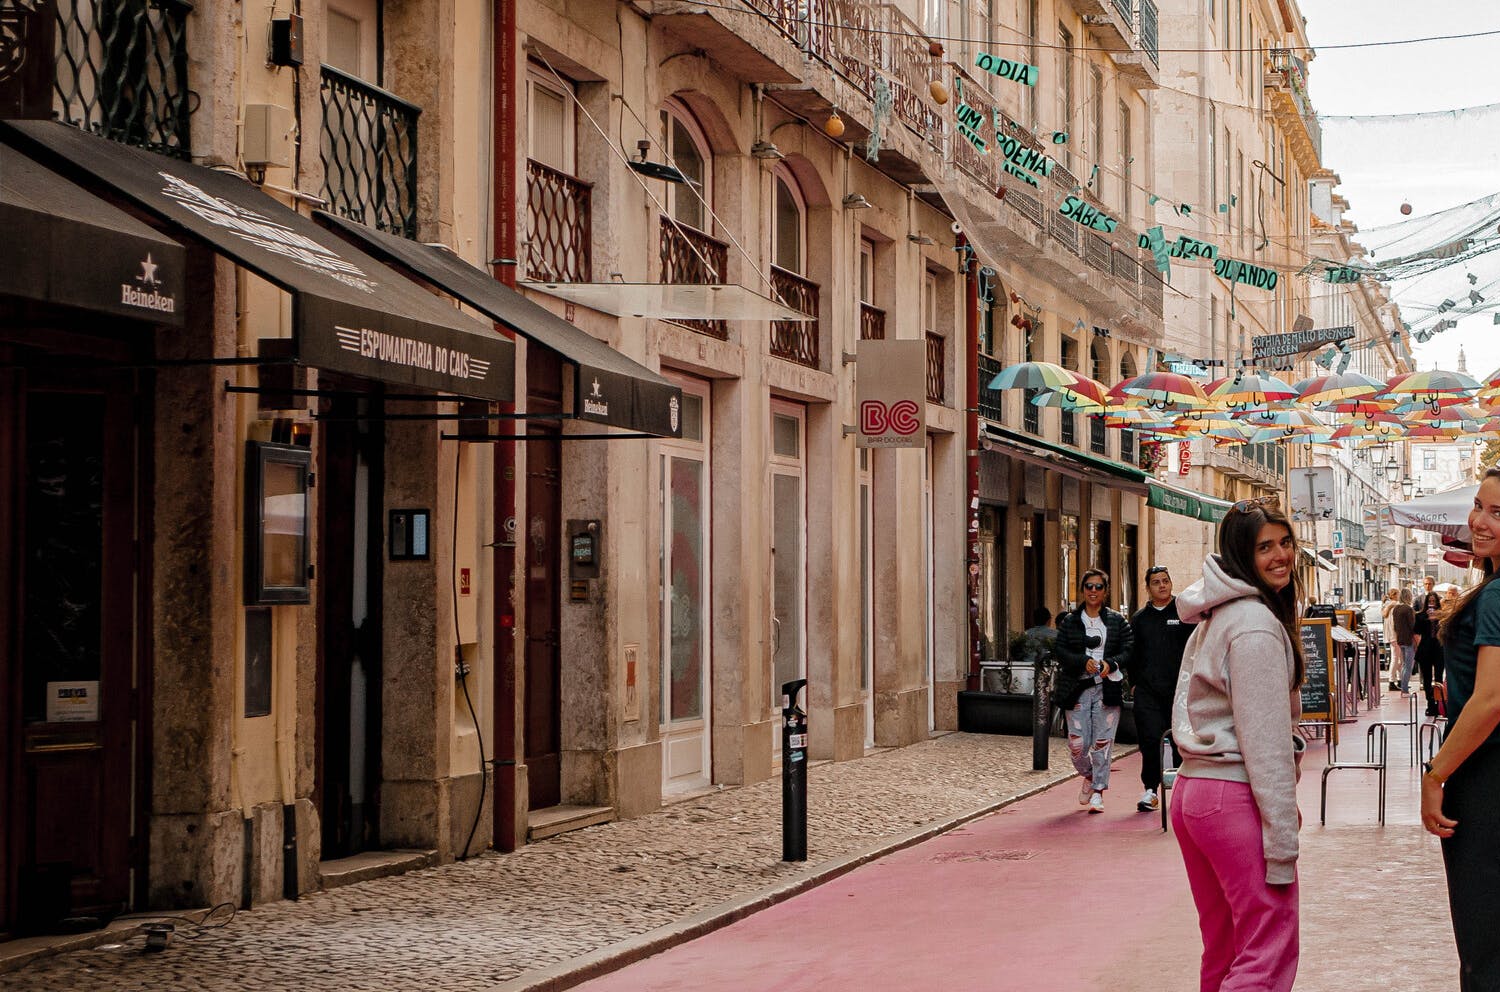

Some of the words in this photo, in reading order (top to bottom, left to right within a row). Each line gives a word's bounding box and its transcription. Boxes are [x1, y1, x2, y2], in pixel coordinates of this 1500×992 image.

[978, 55, 992, 71] O
[996, 59, 1030, 86] DIA
[956, 105, 983, 130] UM
[996, 131, 1048, 177] POEMA
[1059, 195, 1118, 233] SABES
[121, 284, 175, 313] Heineken
[361, 328, 433, 371] ESPUMANTARIA
[435, 346, 447, 374] DO
[450, 350, 469, 379] CAIS
[1252, 335, 1281, 347] SOPHIA
[861, 400, 919, 435] BC
[1415, 512, 1448, 522] SAGRES
